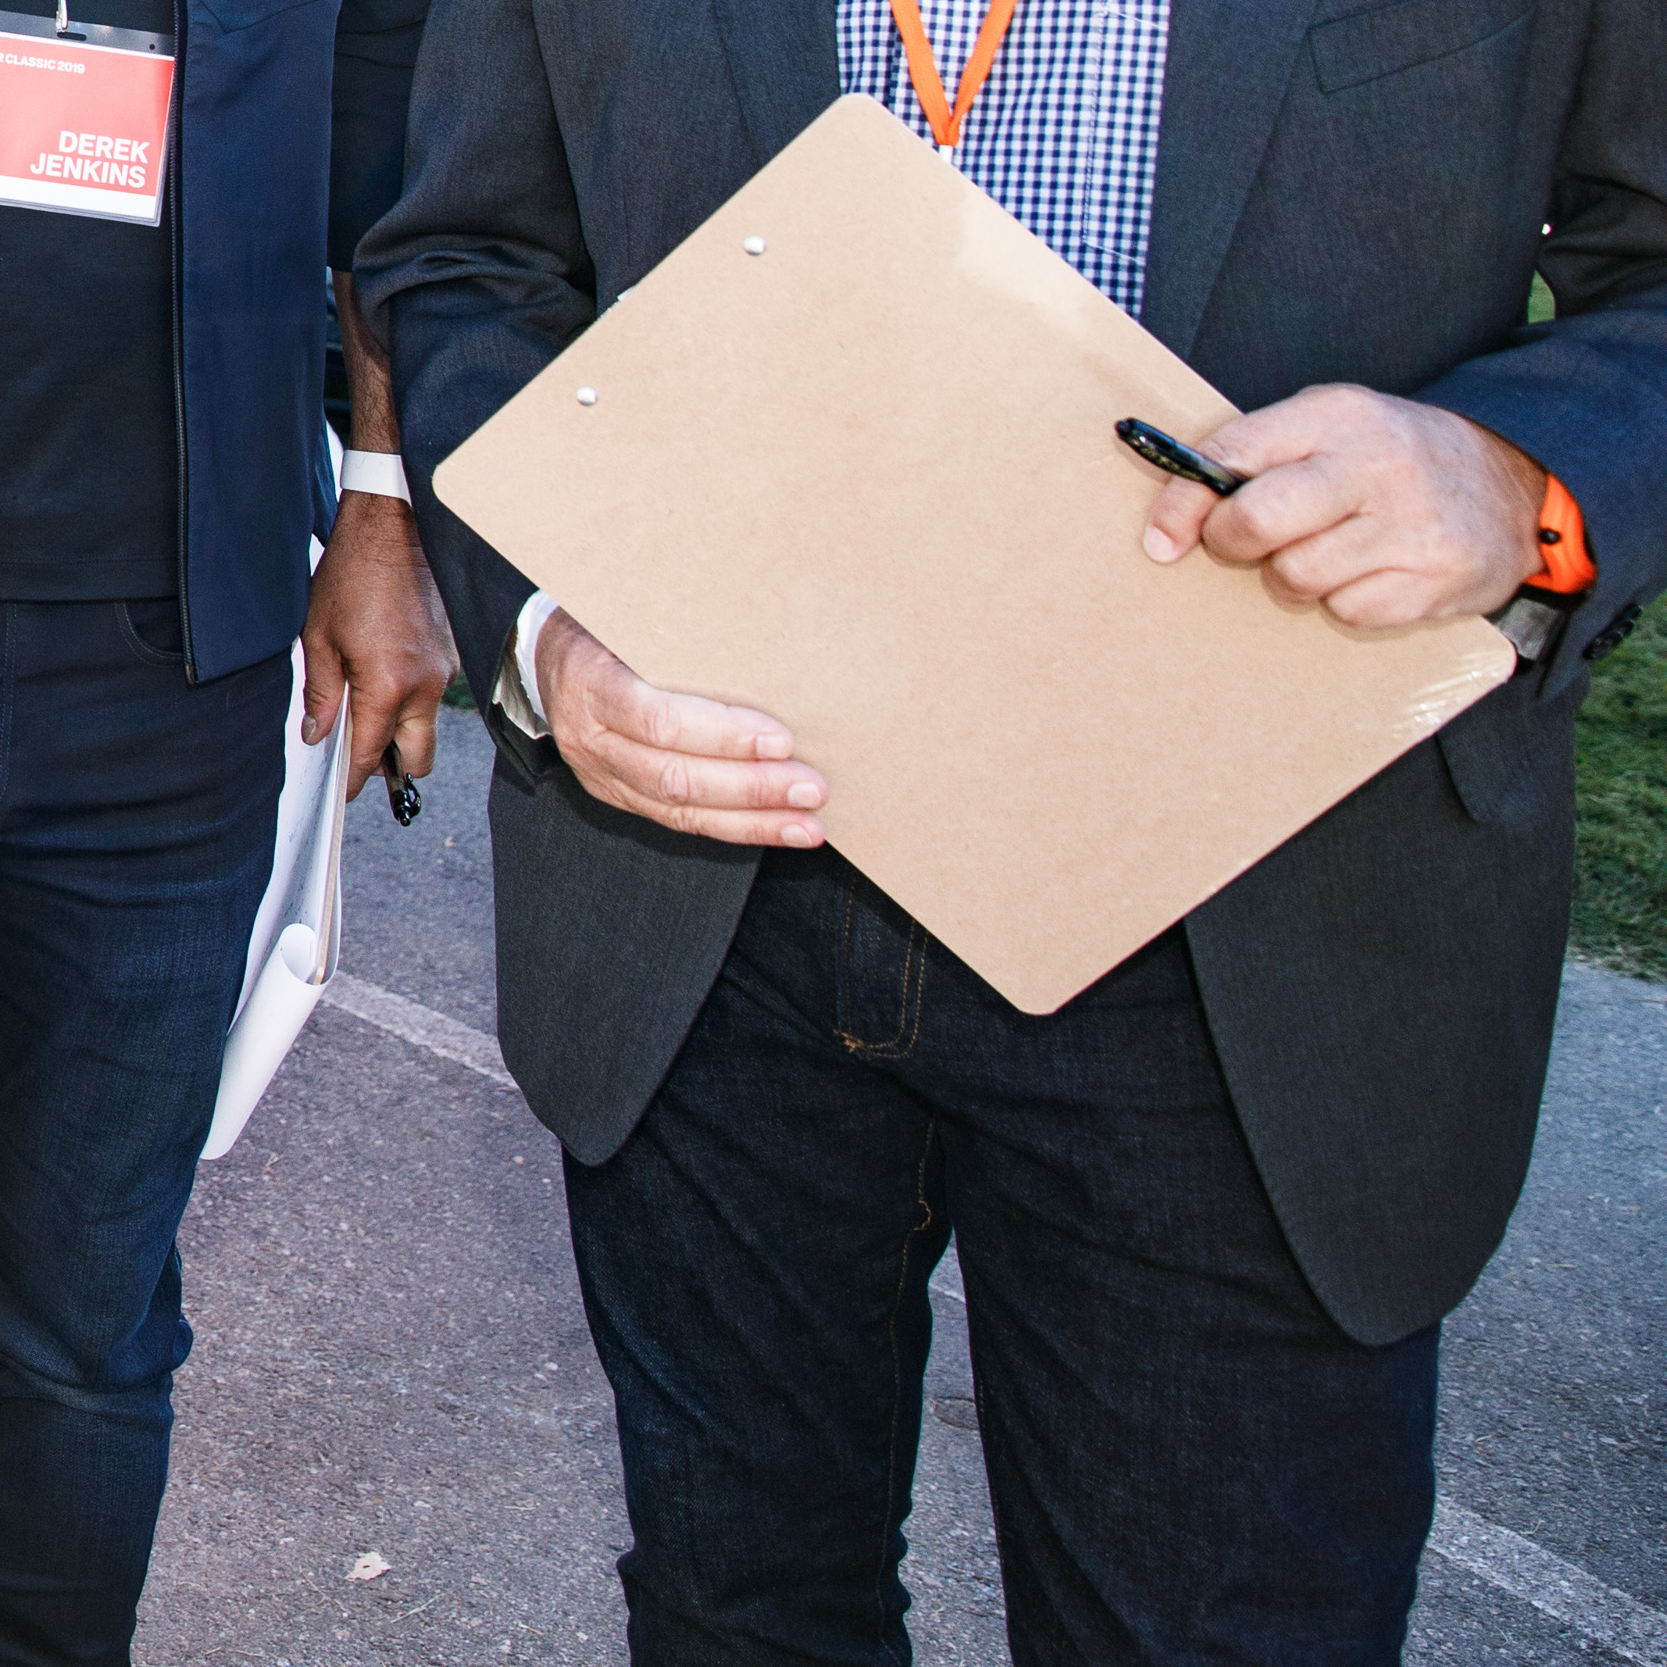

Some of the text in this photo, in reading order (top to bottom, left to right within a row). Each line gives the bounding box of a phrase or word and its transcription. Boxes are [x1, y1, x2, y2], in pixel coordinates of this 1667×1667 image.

[5, 53, 56, 70] CLASSIC
[57, 60, 86, 74] 2019
[58, 130, 150, 164] DEREK
[30, 152, 146, 189] JENKINS
